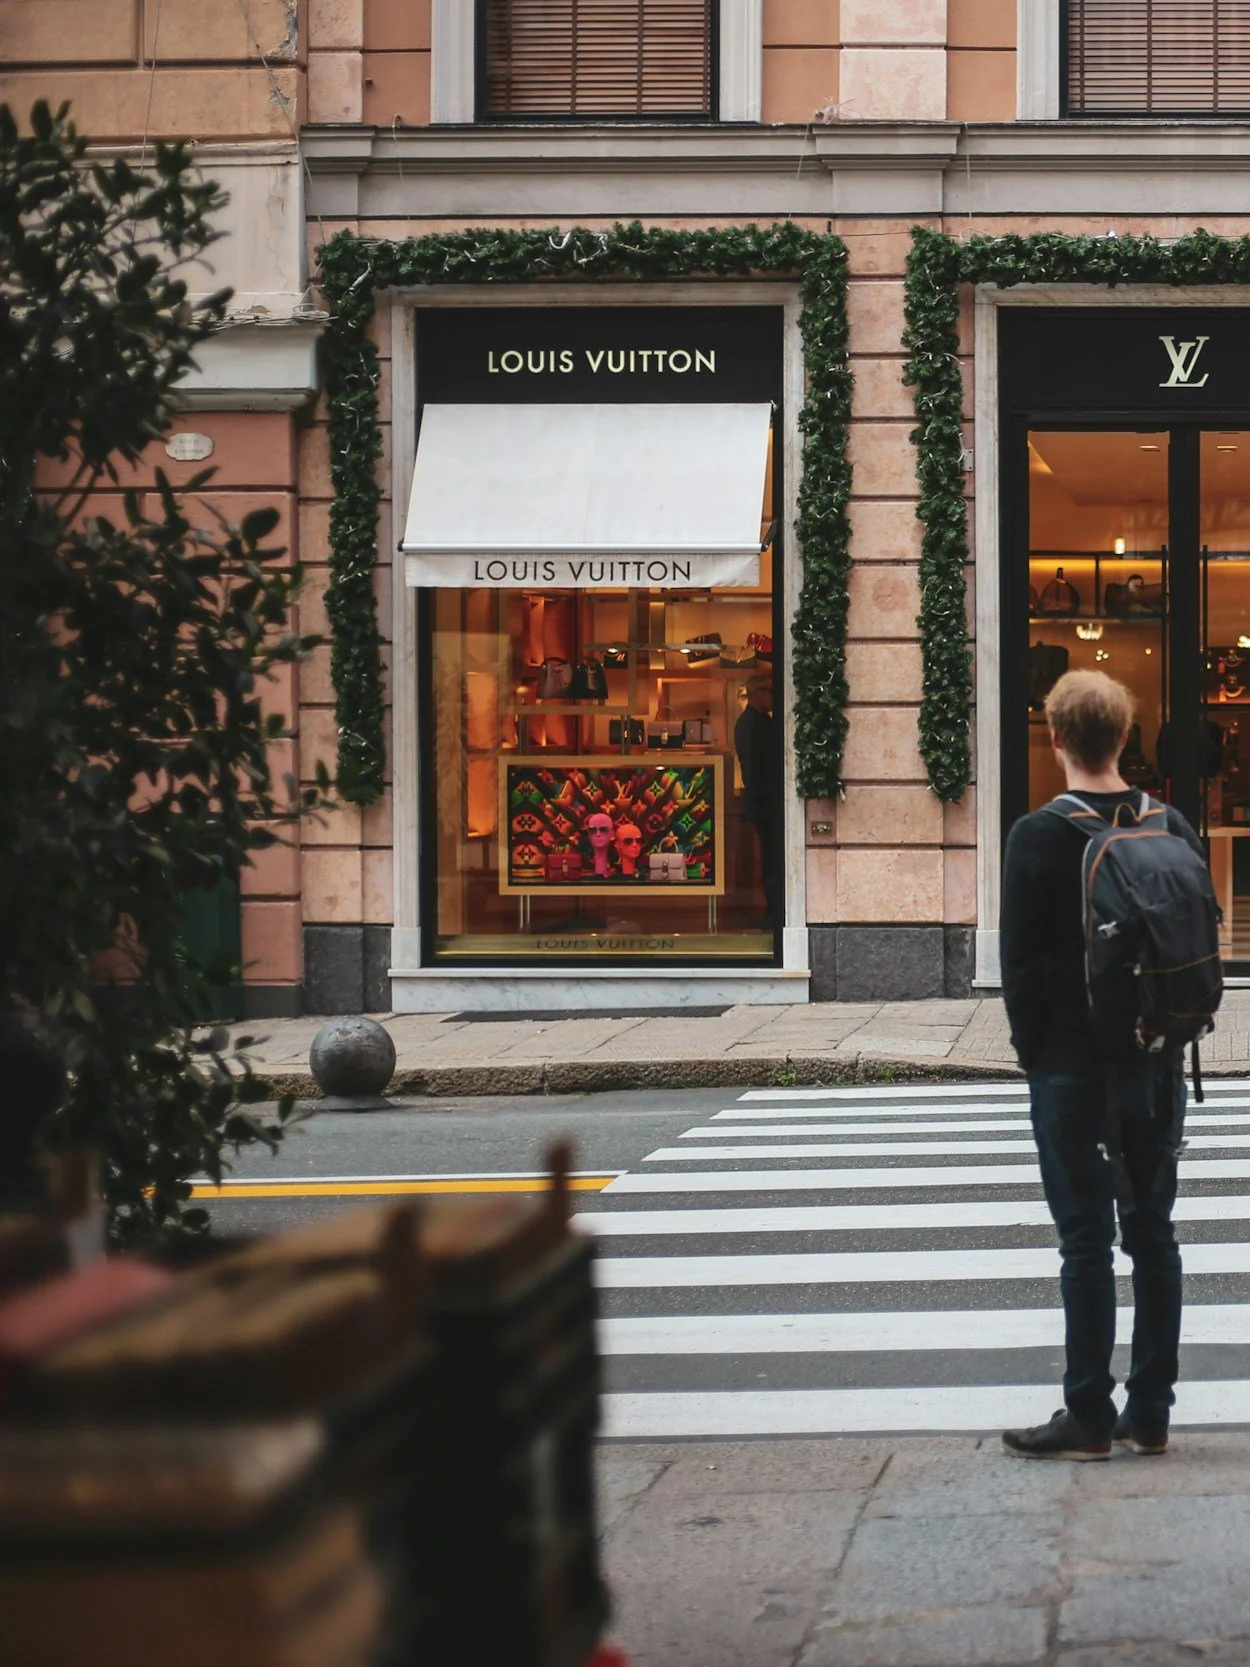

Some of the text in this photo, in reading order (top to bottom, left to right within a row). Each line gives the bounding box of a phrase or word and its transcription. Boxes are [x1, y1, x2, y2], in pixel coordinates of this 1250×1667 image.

[488, 349, 716, 374] LOUIS VUITTON
[1158, 335, 1210, 388] LV
[474, 561, 691, 582] LOUIS VUITTON
[536, 938, 675, 950] LOUIS VUITTON
